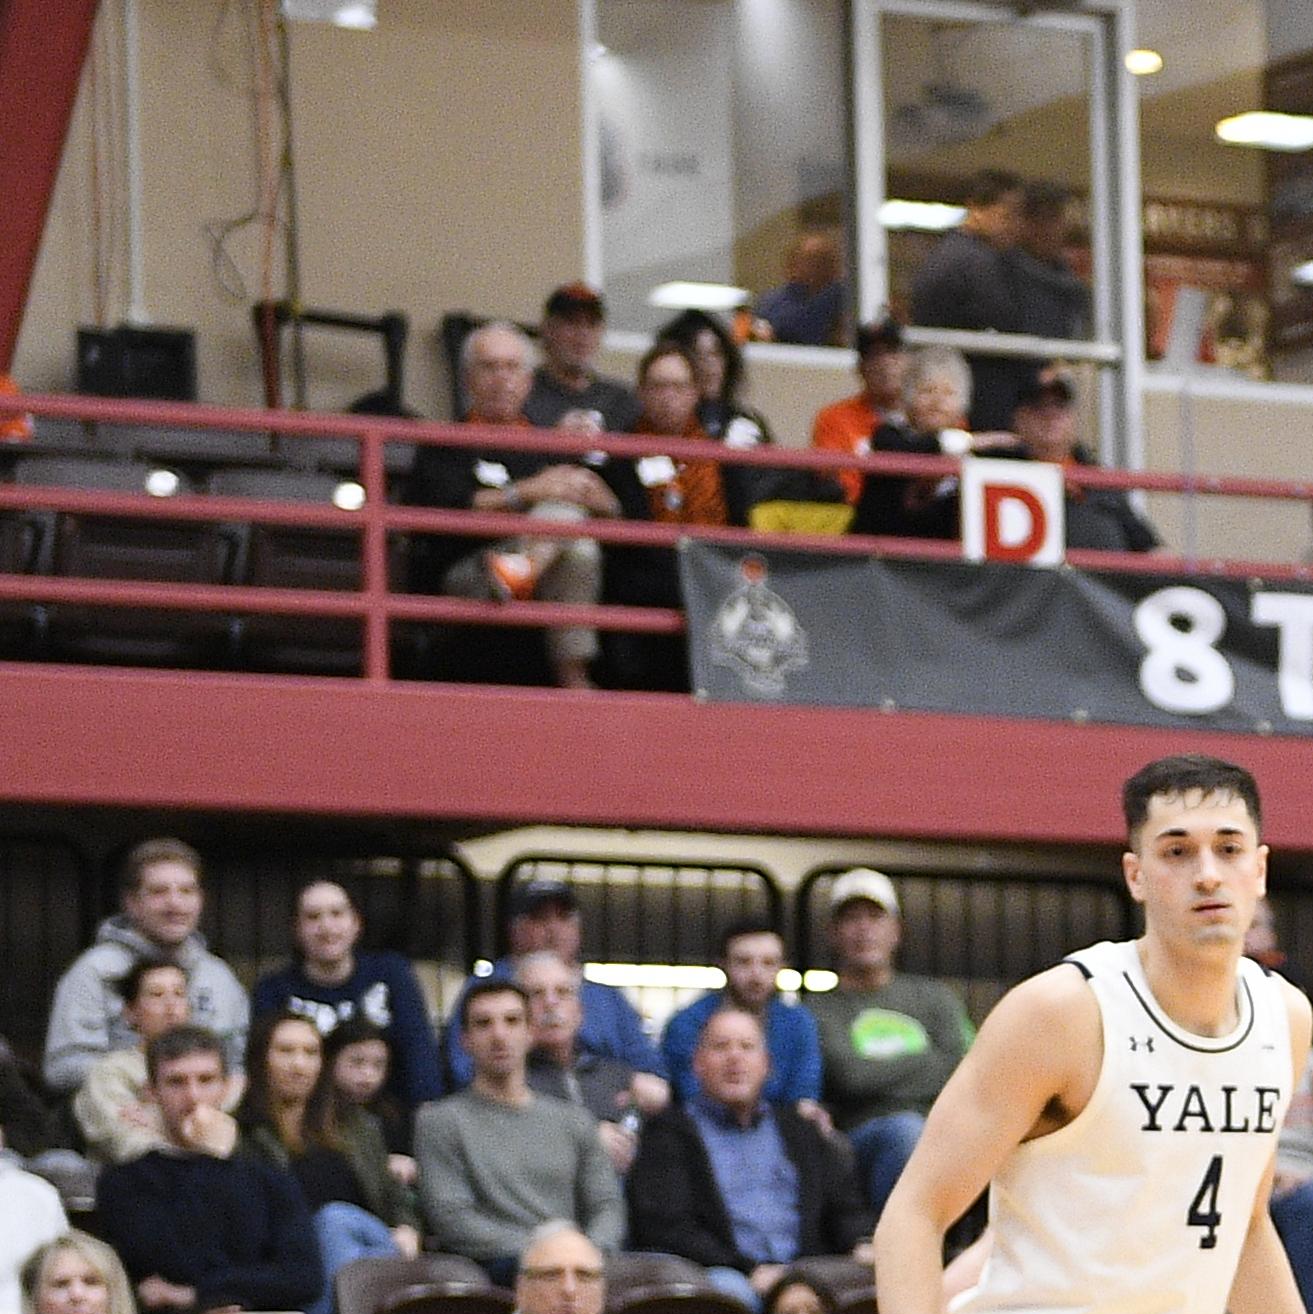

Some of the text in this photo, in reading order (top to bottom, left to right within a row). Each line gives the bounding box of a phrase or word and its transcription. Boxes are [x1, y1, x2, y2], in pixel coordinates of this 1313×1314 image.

[984, 484, 1047, 564] D
[1133, 586, 1235, 715] 8
[1129, 1083, 1281, 1134] YALE
[1186, 1154, 1224, 1250] 4
